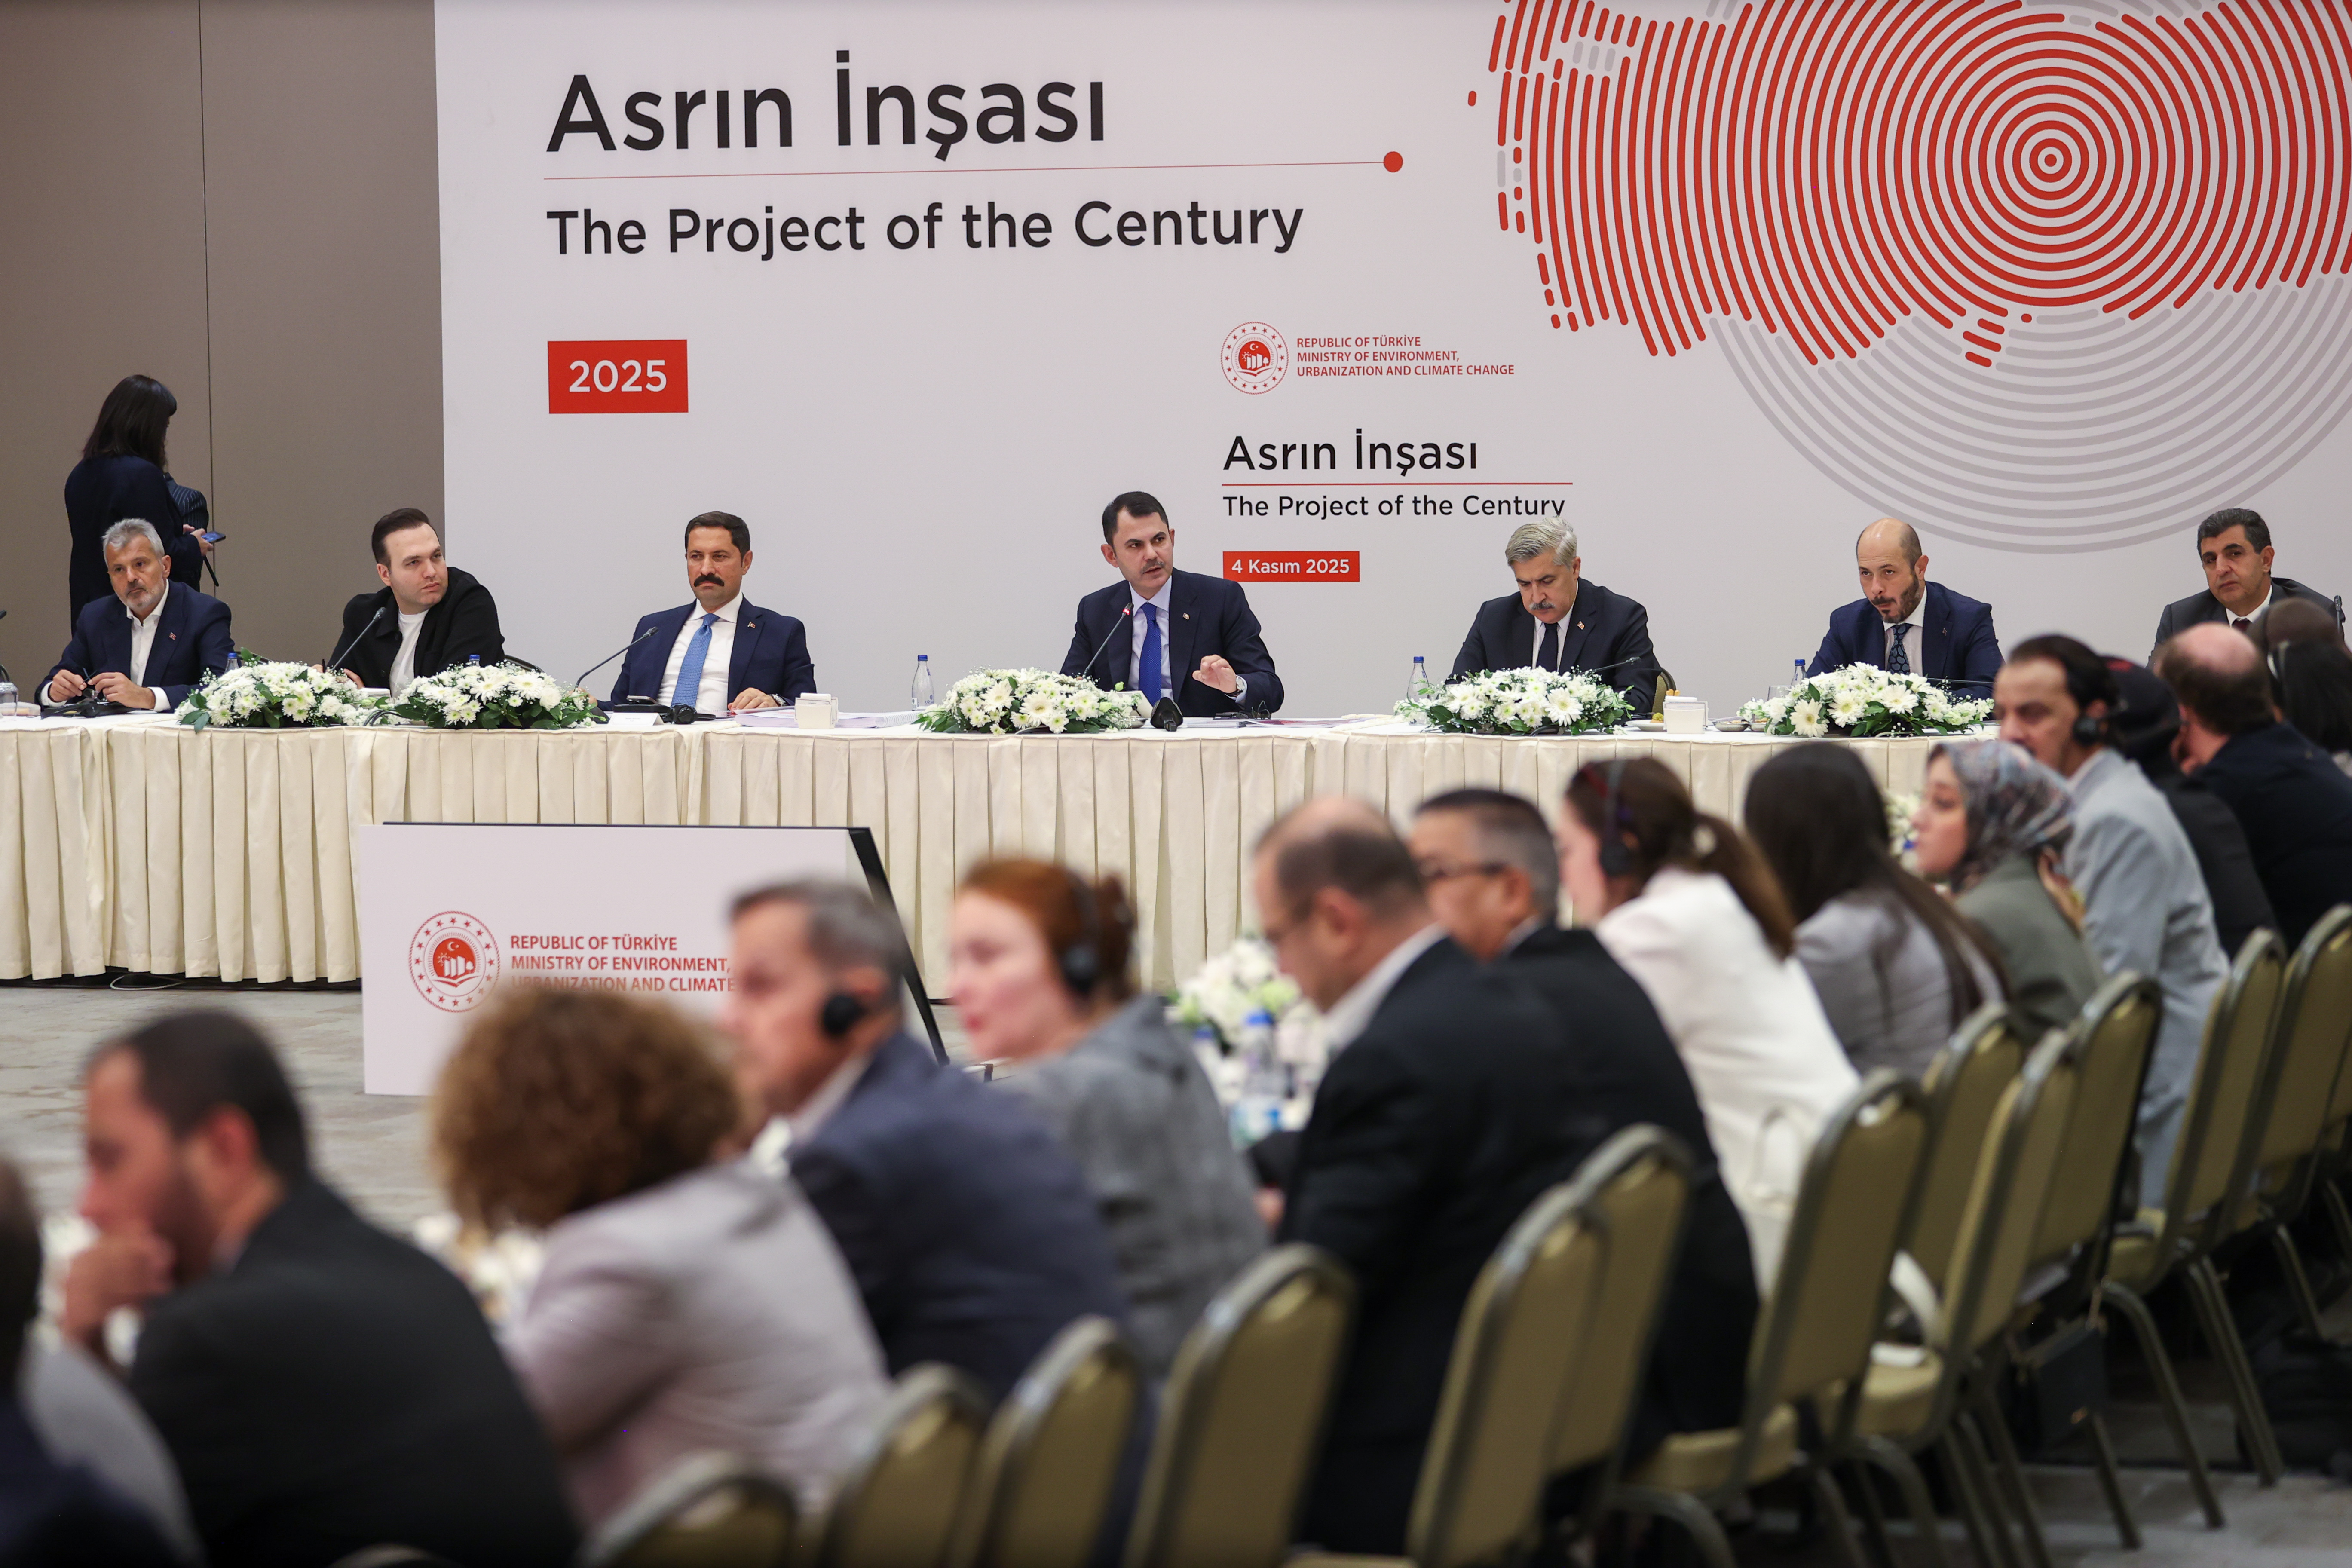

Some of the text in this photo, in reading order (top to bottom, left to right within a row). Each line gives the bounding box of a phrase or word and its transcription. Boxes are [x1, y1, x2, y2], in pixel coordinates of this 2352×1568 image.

[546, 50, 1105, 162] Asrın İnşası
[546, 201, 1305, 262] The Project of the Century
[1297, 334, 1421, 349] REPUBLIC OF TÜRKİYE
[1297, 350, 1460, 363] MINISTRY OF ENVIRONMENT,
[568, 359, 668, 393] 2025
[1297, 364, 1515, 377] URBANIZATION AND CLIMATE CHANGE
[1223, 428, 1477, 477] Asrın İnşası
[1223, 494, 1566, 521] The Project of the Century
[1231, 559, 1350, 574] 4 Kasım 2025
[511, 933, 678, 952] REPUBLIC OF TÜRKİYE
[511, 956, 731, 973] MINISTRY OF ENVIRONMENT,
[631, 977, 666, 992] AND
[669, 977, 735, 992] CLIMATE
